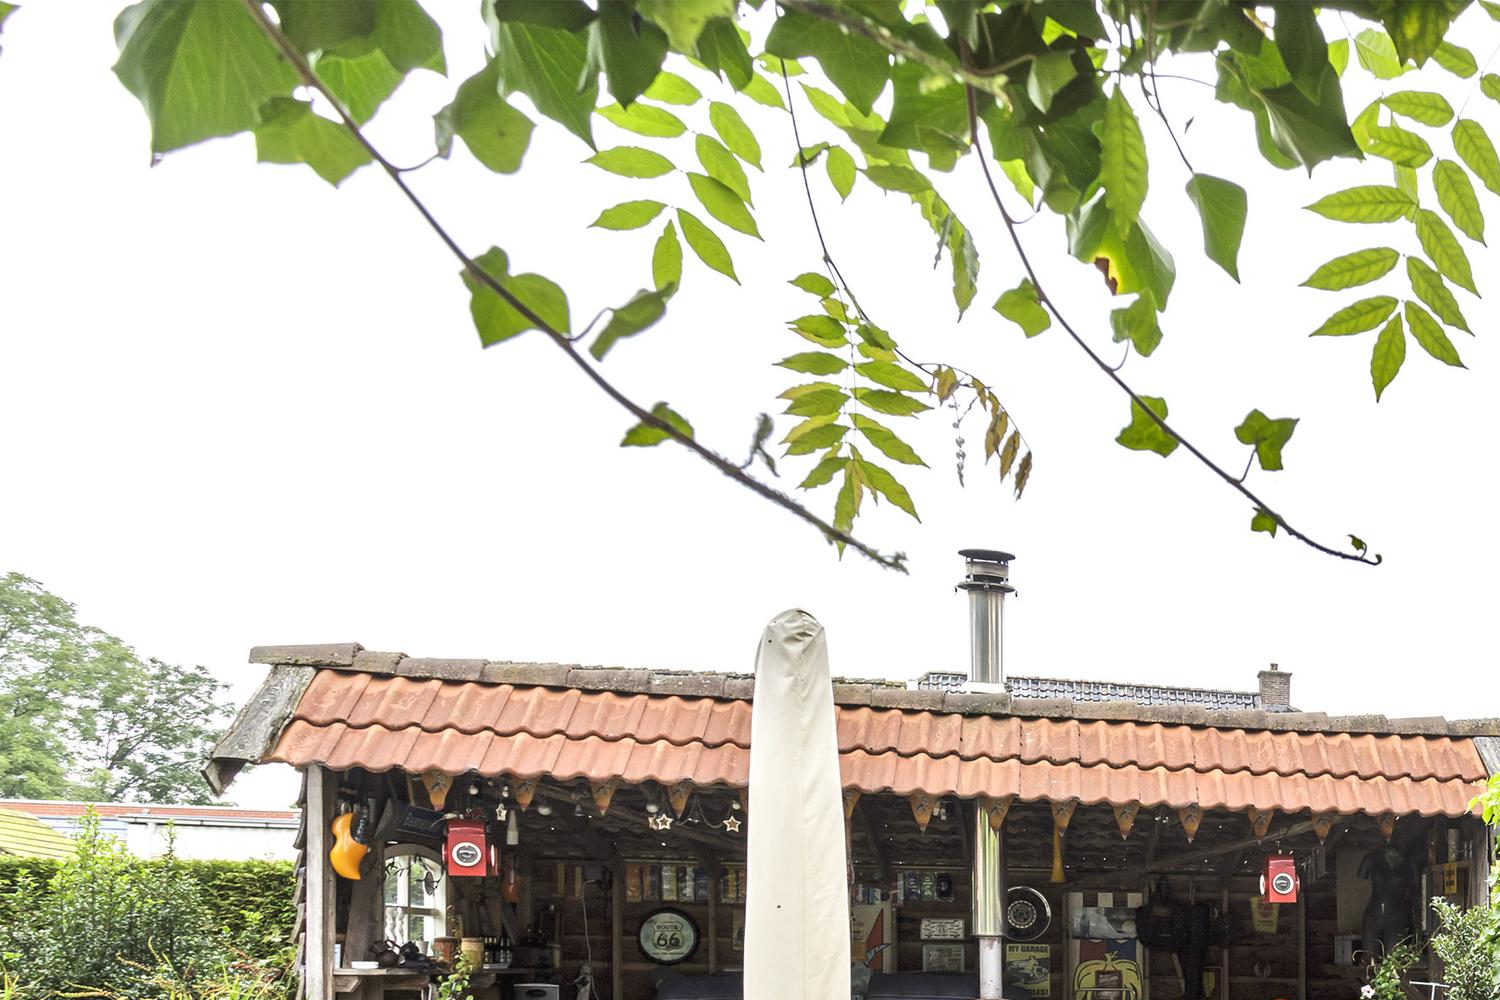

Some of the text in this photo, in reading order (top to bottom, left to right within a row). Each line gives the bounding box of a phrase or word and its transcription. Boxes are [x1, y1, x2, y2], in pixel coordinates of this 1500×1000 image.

[657, 932, 680, 947] 66
[1008, 945, 1048, 953] MY GARAGE
